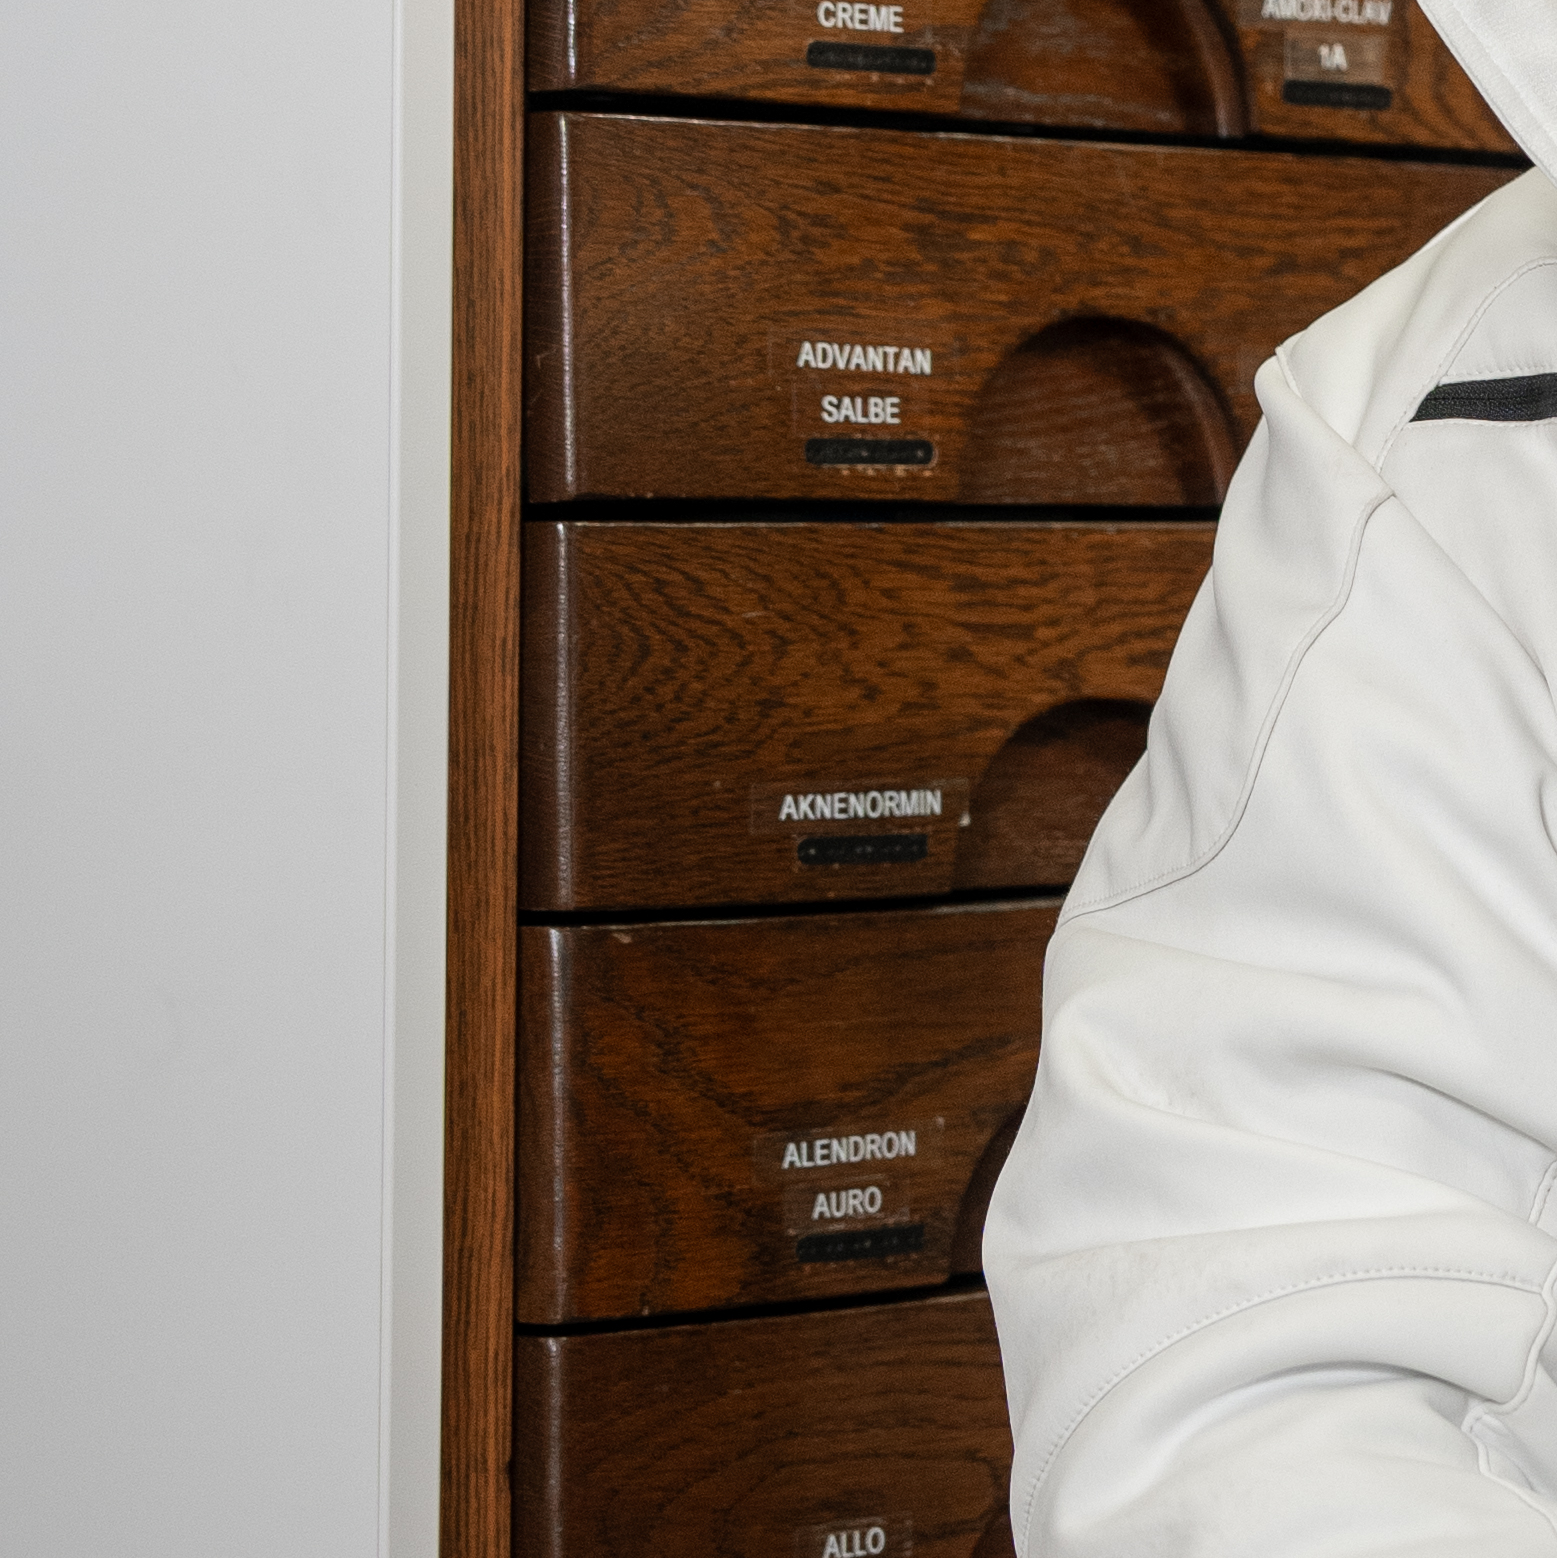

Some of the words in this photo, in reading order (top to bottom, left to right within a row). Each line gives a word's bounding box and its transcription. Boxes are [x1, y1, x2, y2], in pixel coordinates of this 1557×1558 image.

[817, 0, 904, 33] CREME
[797, 341, 932, 375] ADVANTAN
[821, 395, 901, 425] SALBE
[779, 789, 942, 821] AKNENORMIN
[782, 1130, 917, 1169] ALENDRON
[812, 1186, 883, 1220] AURO
